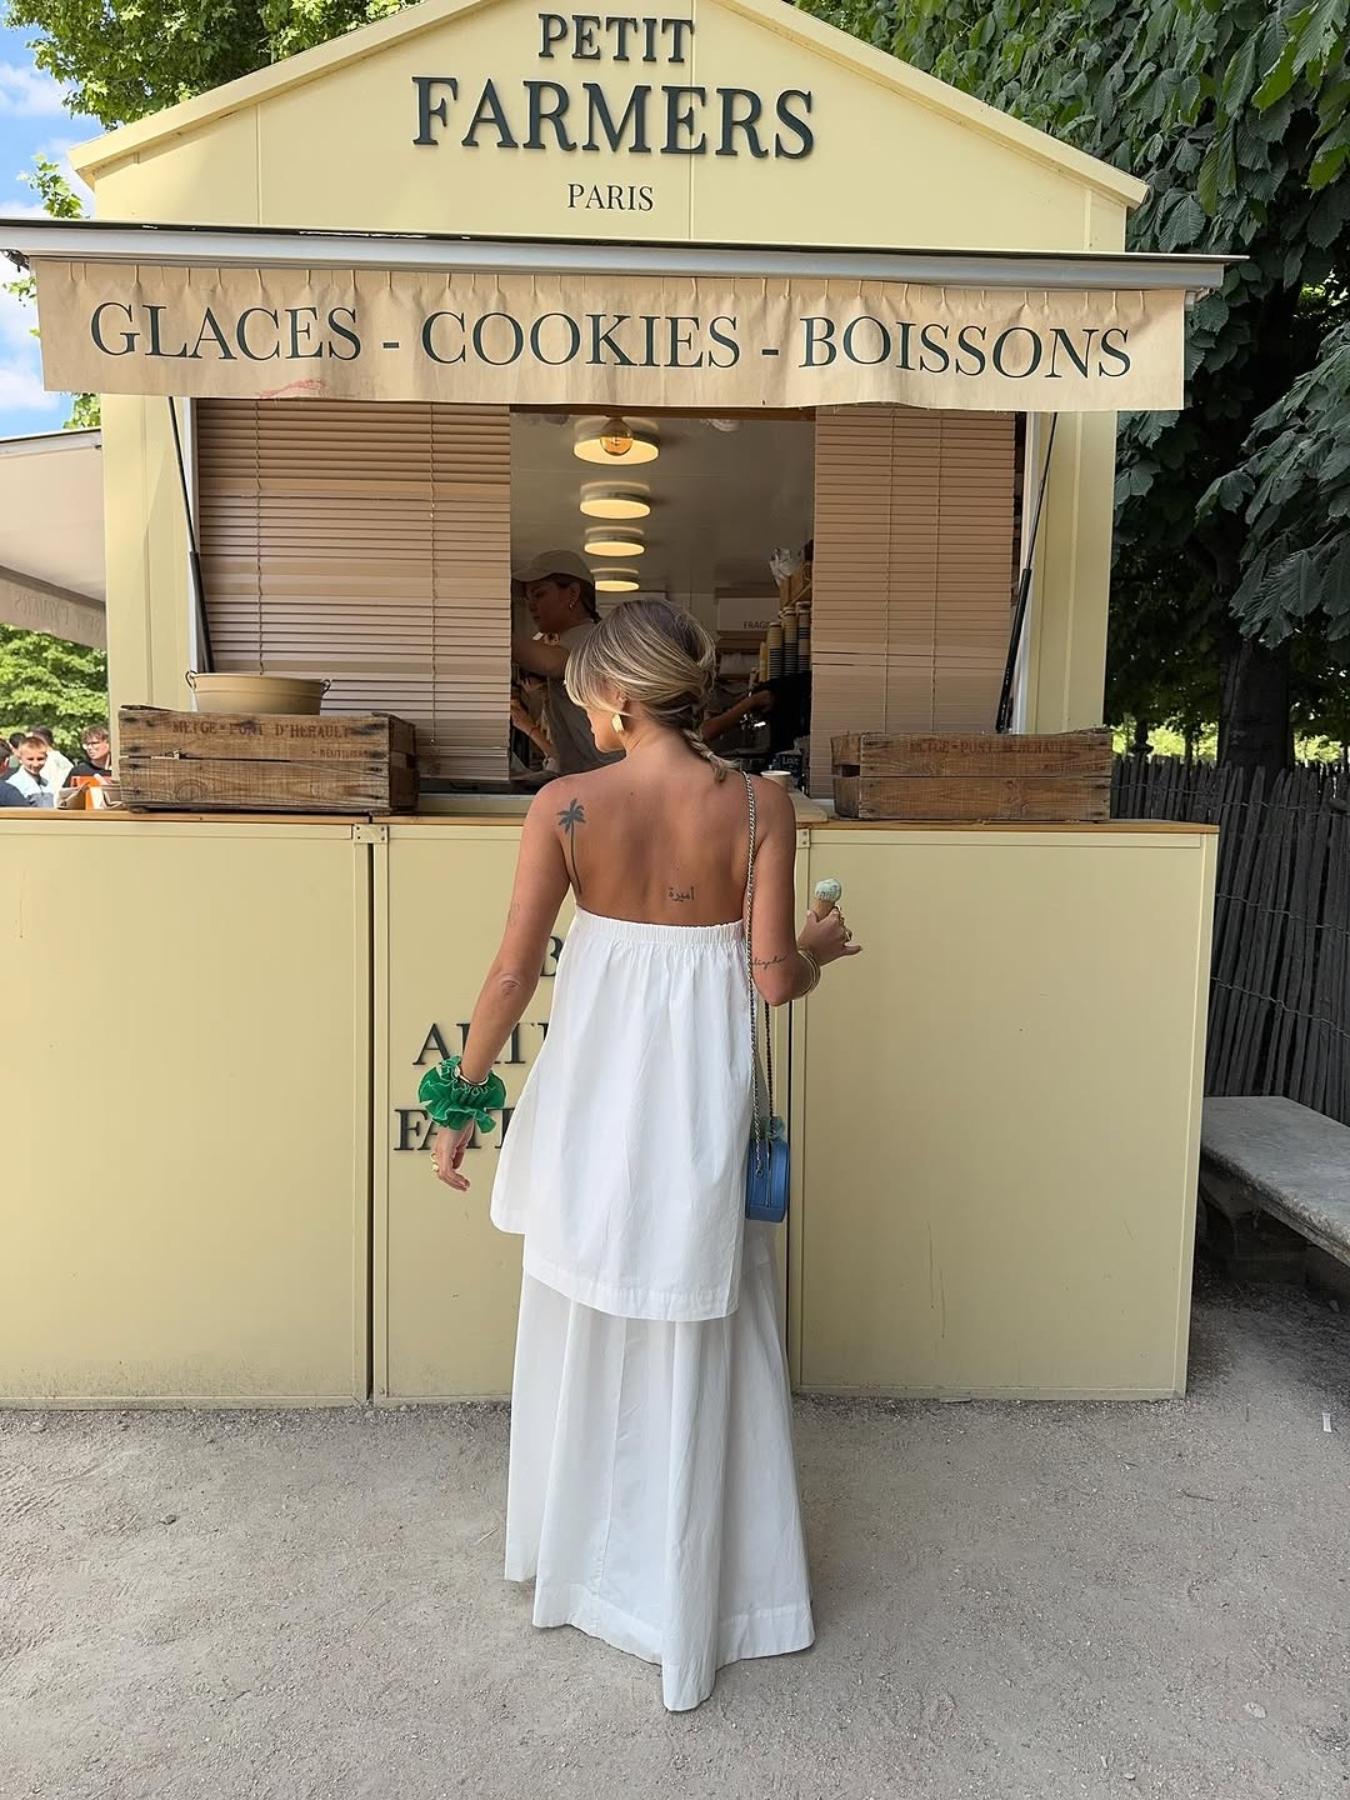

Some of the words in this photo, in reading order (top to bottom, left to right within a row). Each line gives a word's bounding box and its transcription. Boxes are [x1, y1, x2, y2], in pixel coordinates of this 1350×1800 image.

[538, 13, 694, 64] PETIT
[411, 76, 814, 160] FARMERS
[567, 183, 653, 211] PARIS
[91, 302, 361, 361] GLACES
[421, 311, 740, 368] COOKIES
[798, 315, 1131, 379] BOISSONS
